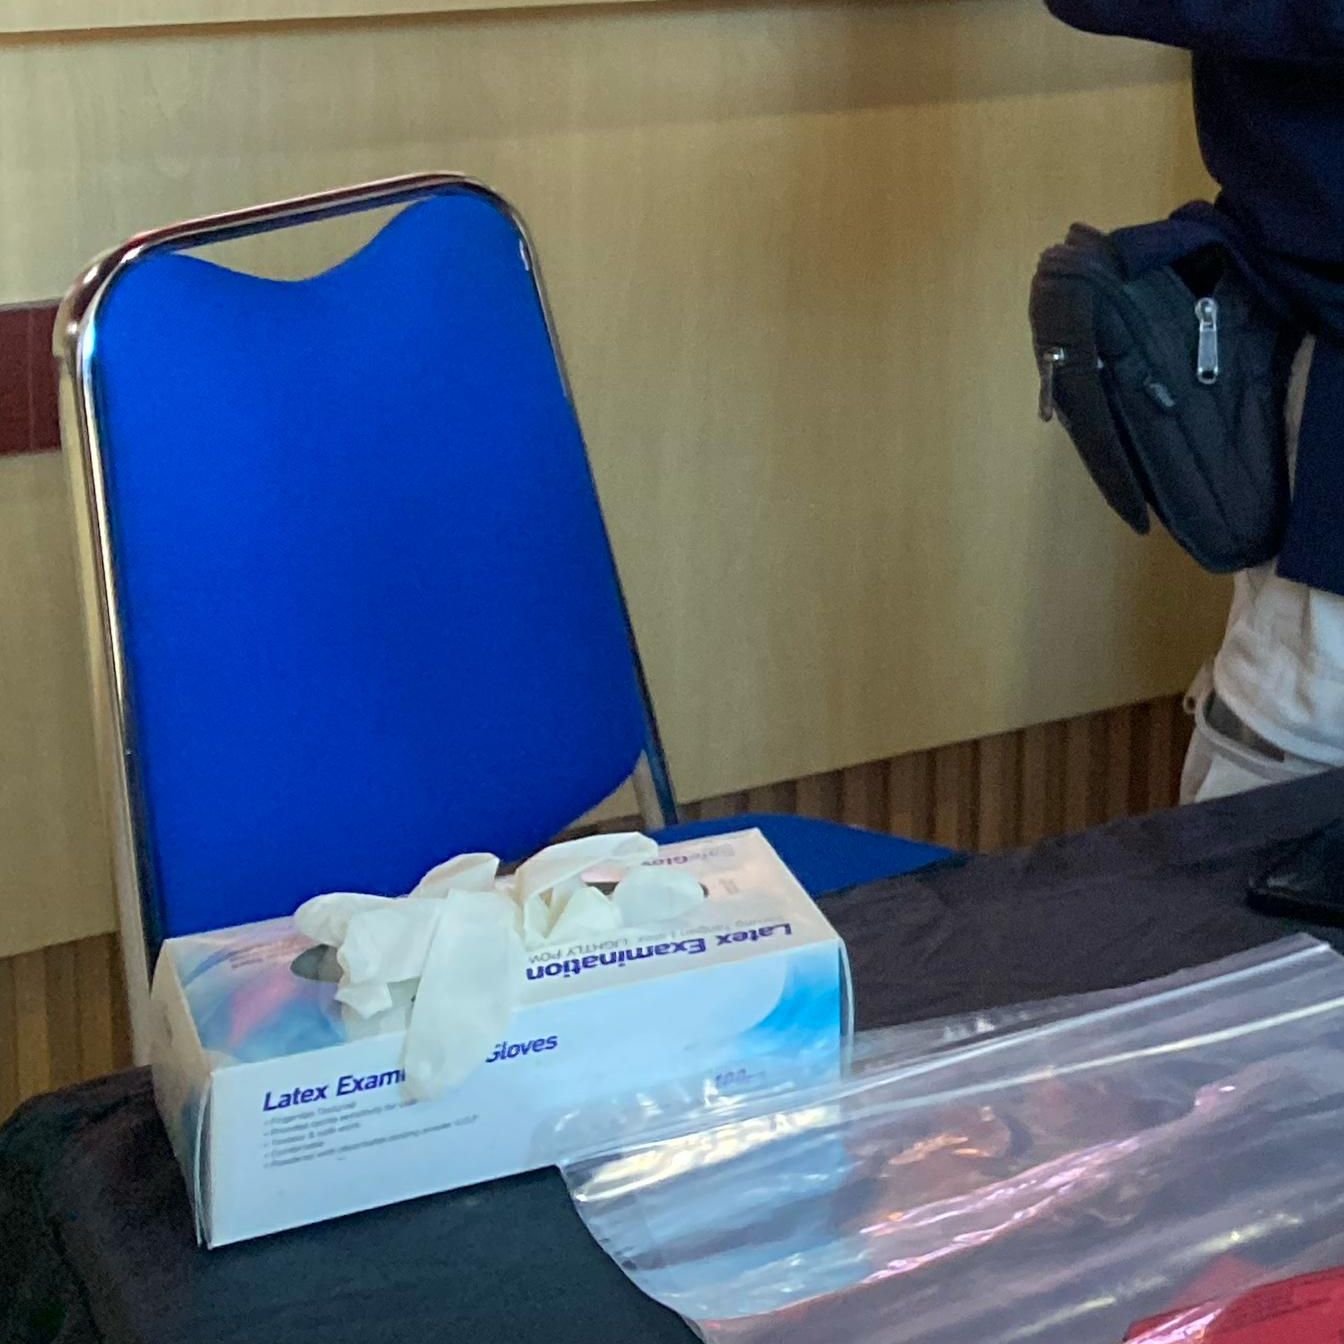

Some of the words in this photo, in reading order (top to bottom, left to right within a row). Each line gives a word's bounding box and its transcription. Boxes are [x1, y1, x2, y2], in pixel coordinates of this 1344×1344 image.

[717, 923, 792, 946] Latex
[526, 937, 706, 980] Examination
[263, 1085, 329, 1112] Latex
